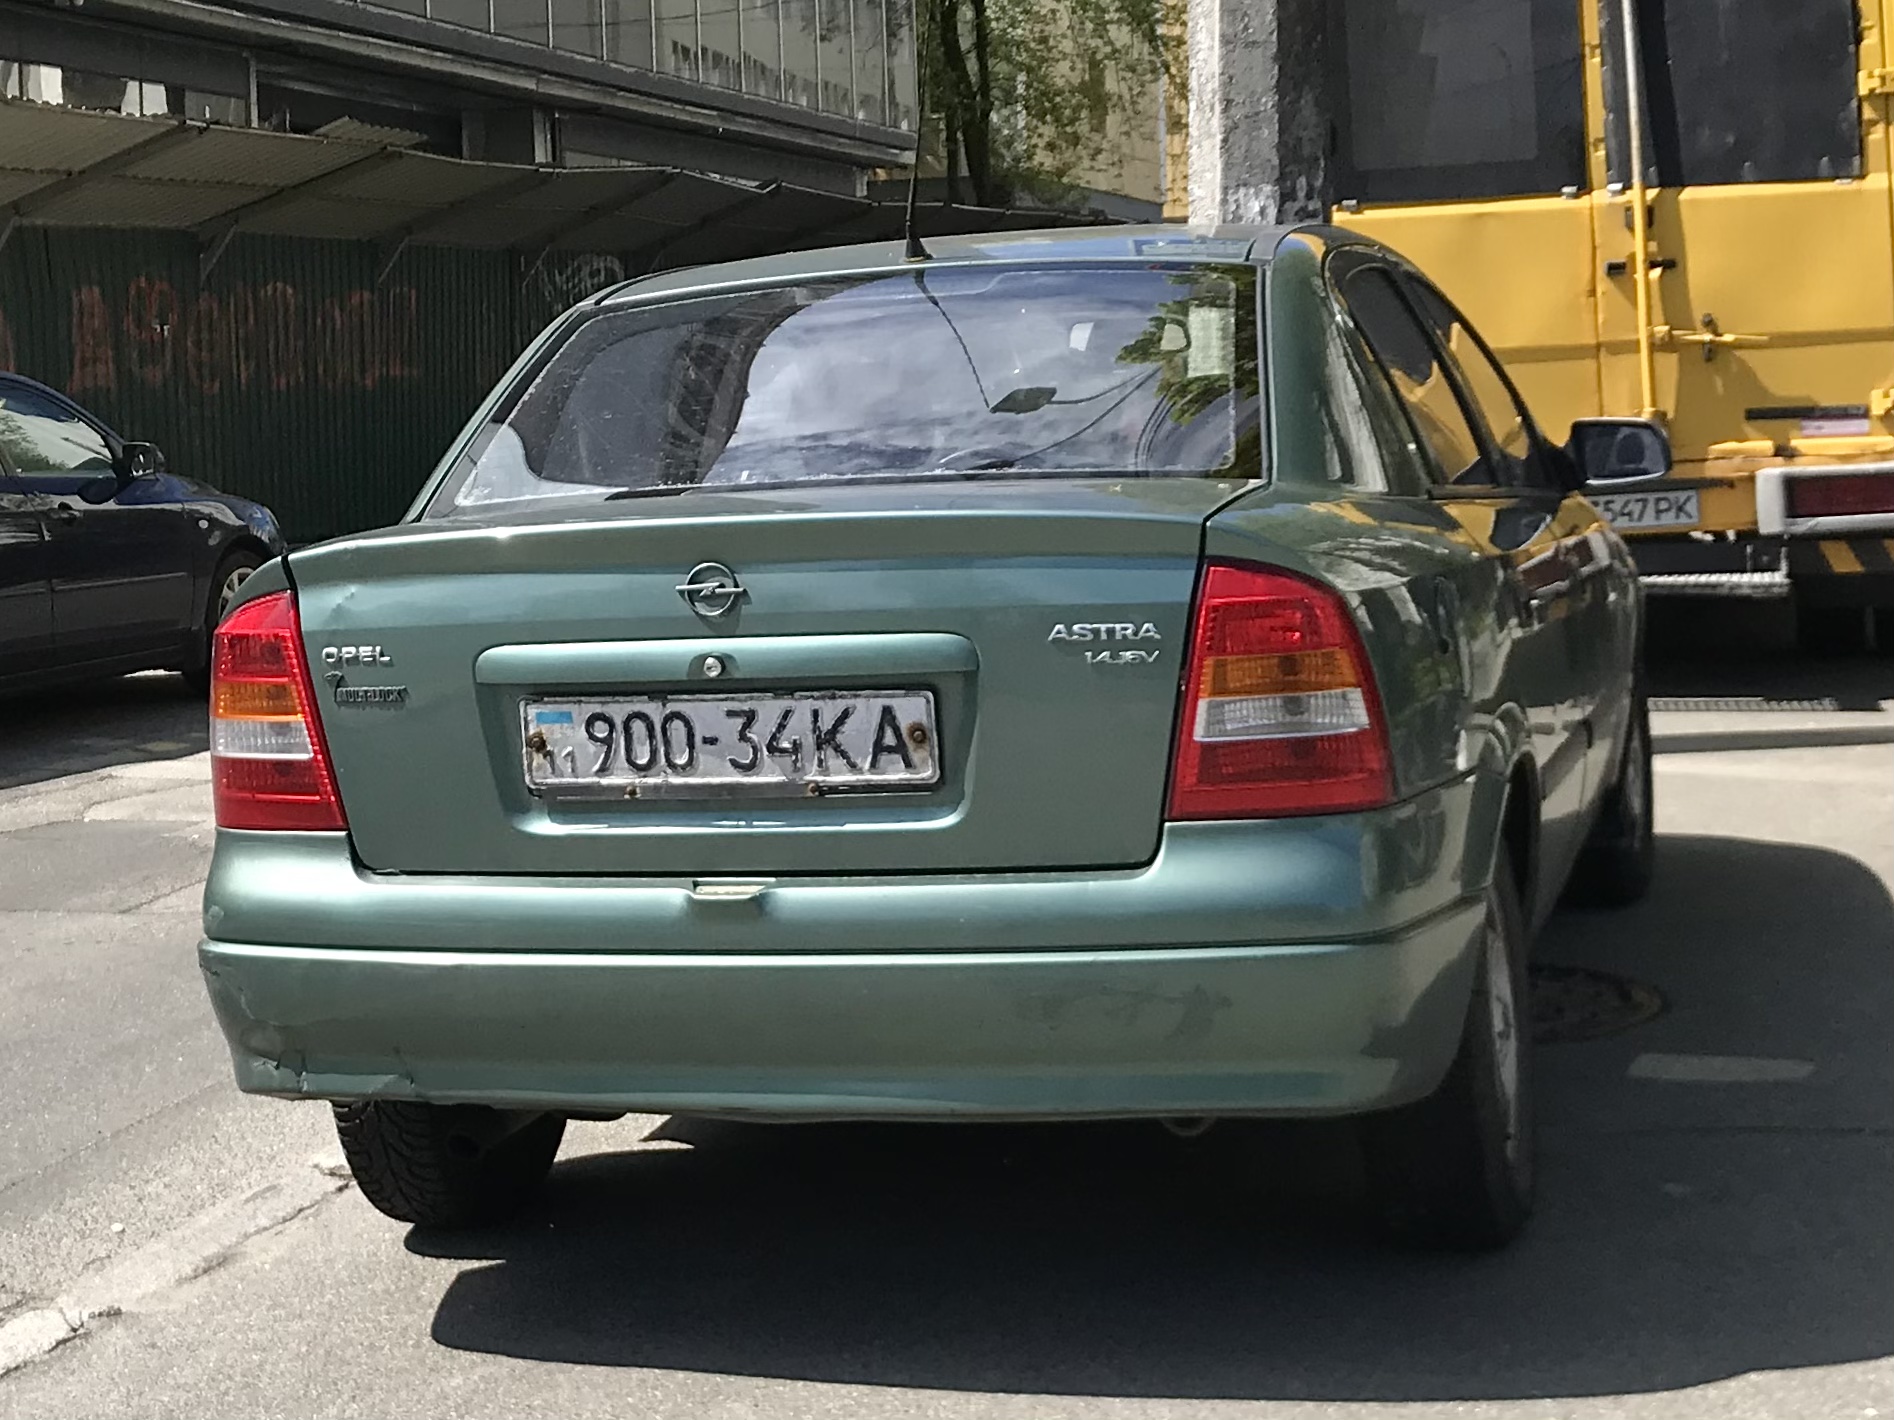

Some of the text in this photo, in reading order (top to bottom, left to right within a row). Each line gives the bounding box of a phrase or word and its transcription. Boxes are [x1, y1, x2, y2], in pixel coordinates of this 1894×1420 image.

[1591, 494, 1695, 522] 547PK
[1047, 622, 1162, 641] ASTRA
[321, 645, 392, 663] OPEL
[583, 703, 914, 774] 900-34KA
